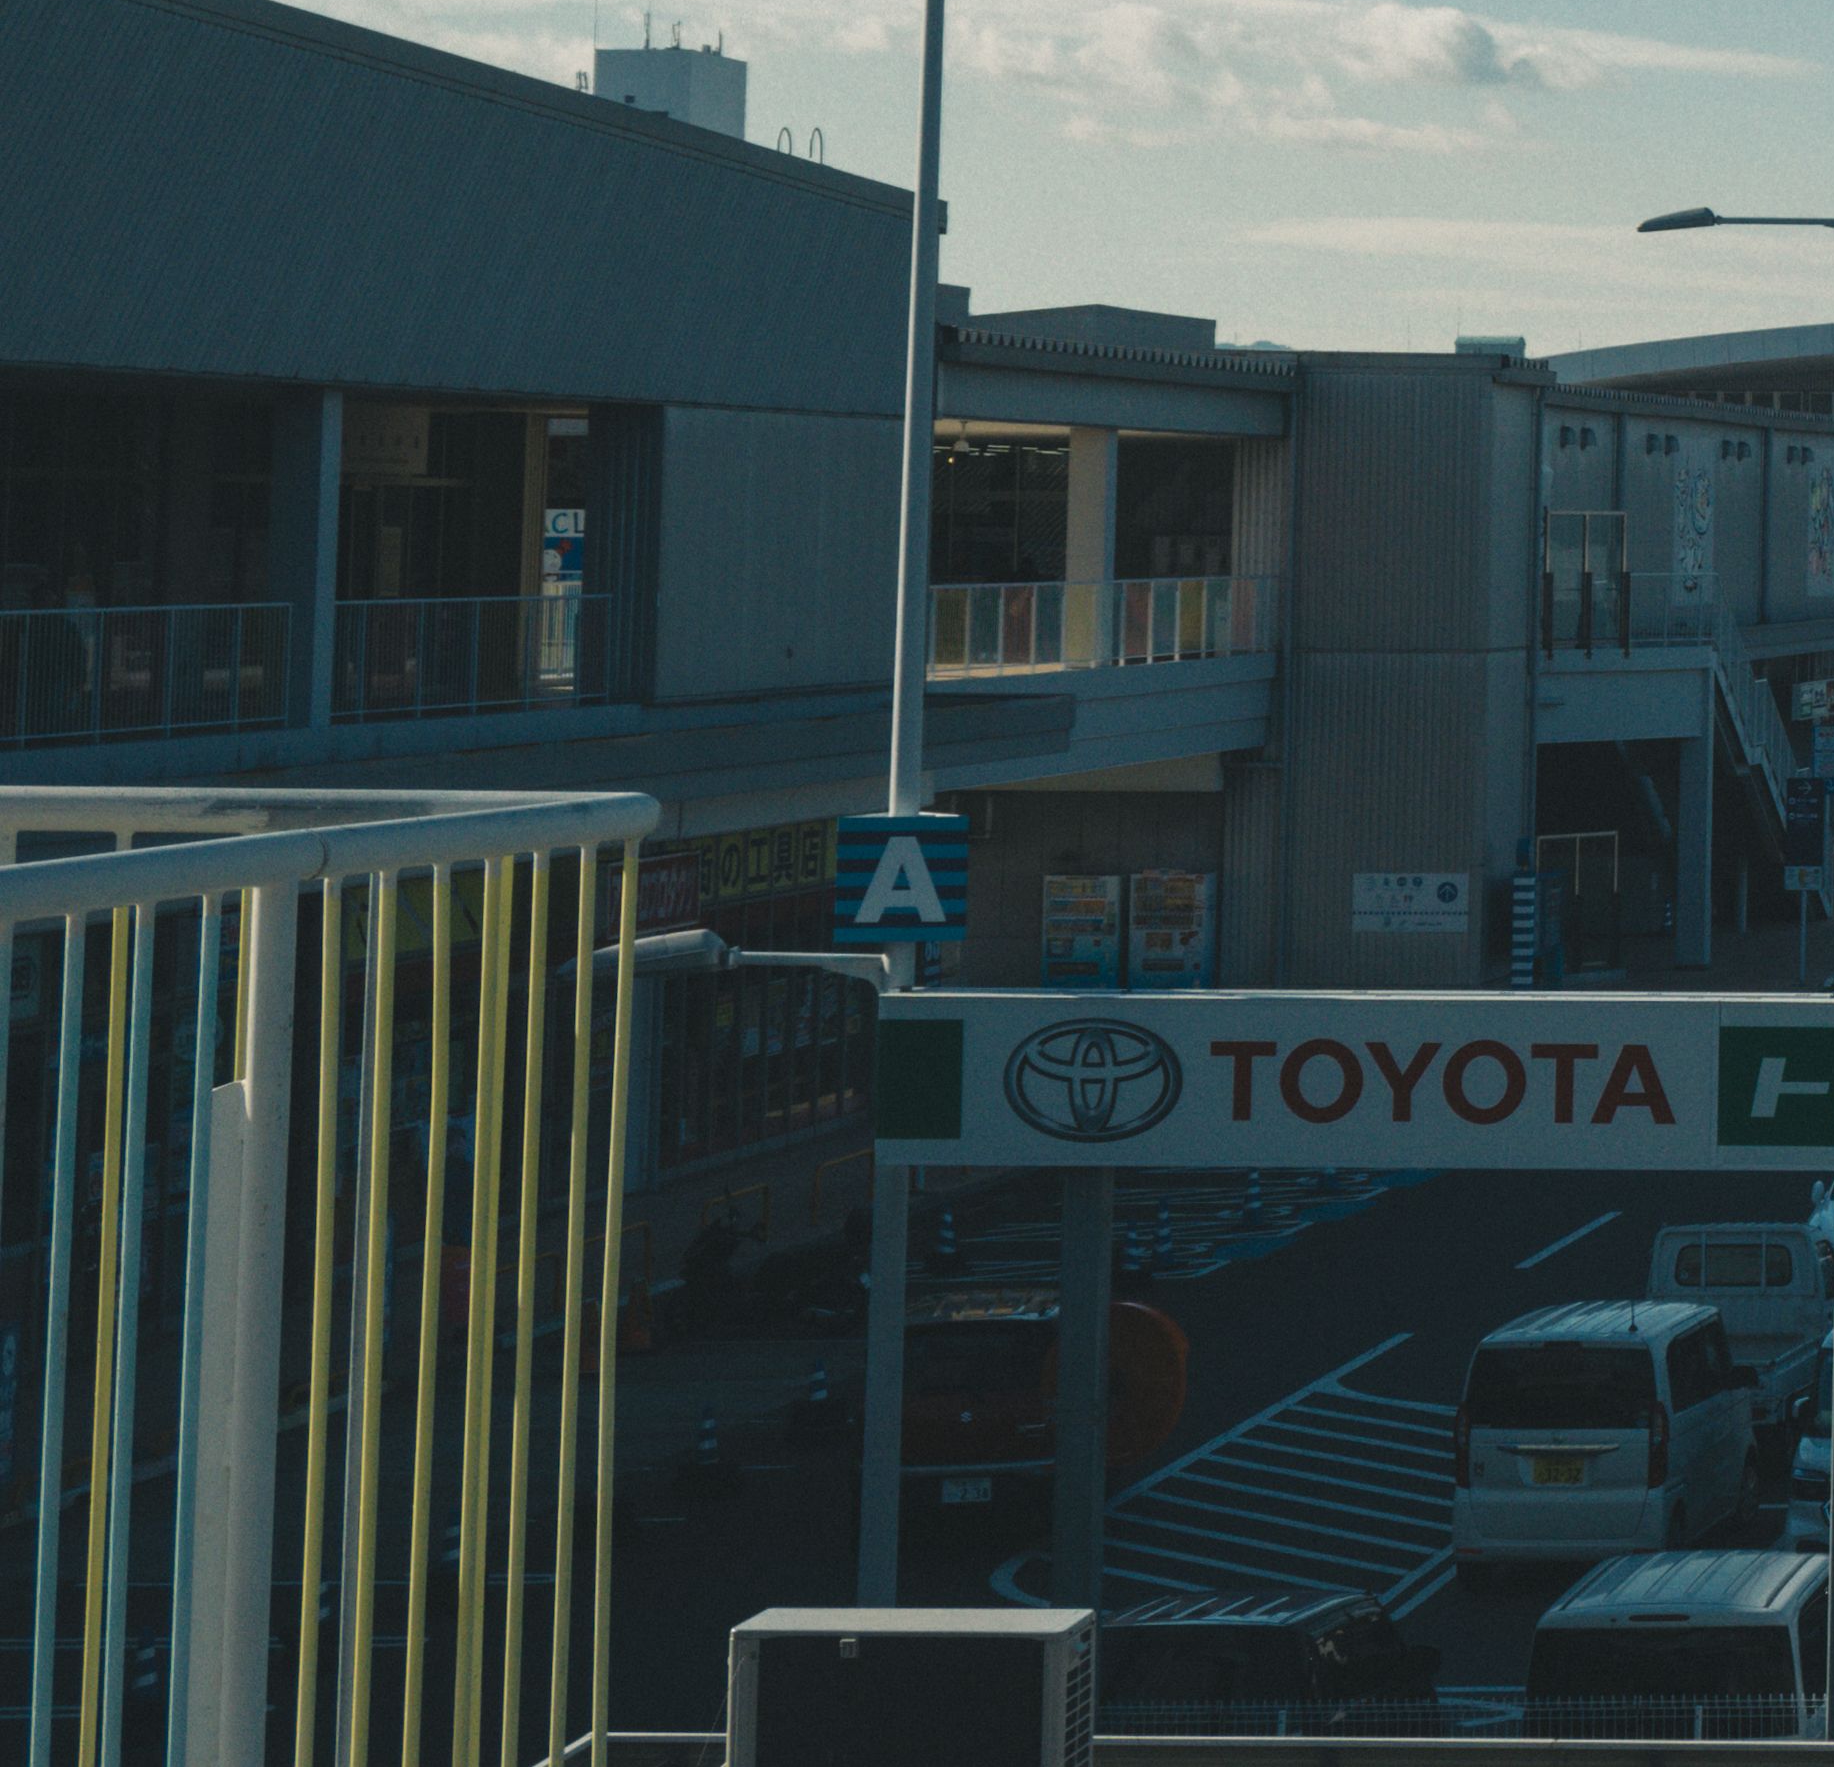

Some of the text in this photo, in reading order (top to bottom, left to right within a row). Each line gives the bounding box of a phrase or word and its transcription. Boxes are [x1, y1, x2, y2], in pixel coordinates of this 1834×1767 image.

[545, 512, 584, 534] CL
[853, 835, 947, 924] A
[1211, 1039, 1674, 1124] TOYOTA
